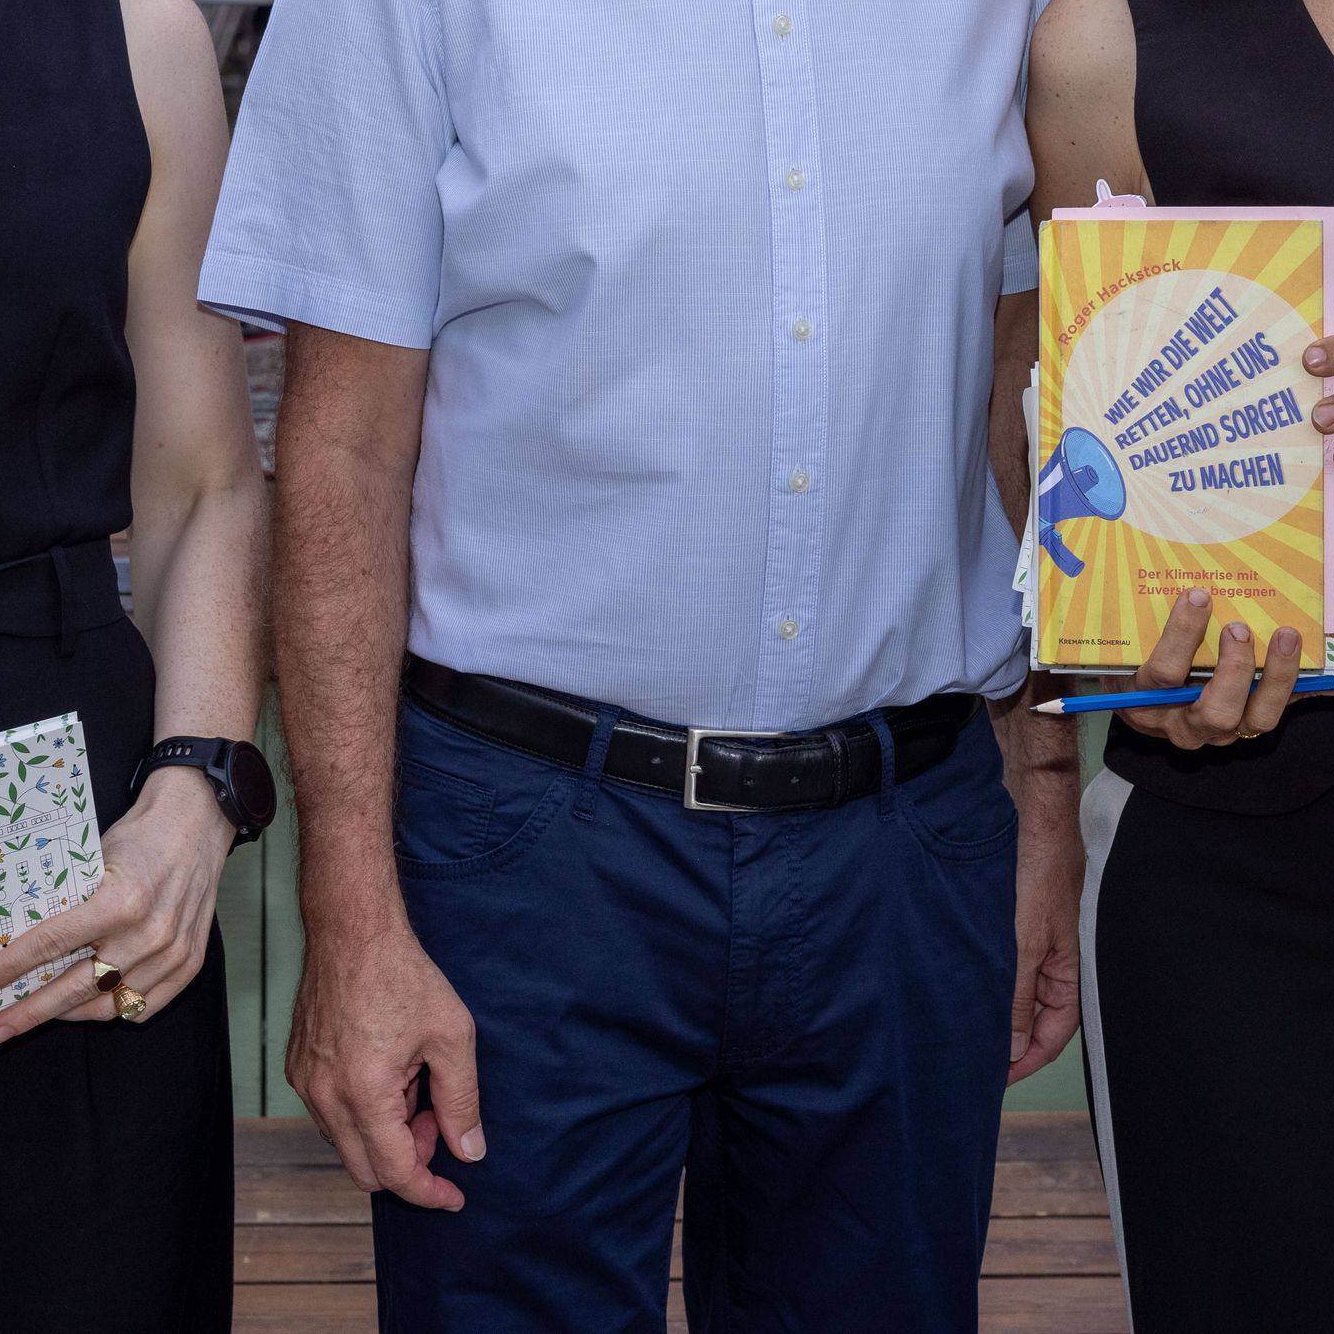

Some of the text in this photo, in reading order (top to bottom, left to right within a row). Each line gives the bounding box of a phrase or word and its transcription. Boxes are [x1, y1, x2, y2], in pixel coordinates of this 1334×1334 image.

[1058, 259, 1182, 345] Roger Hackstock
[1104, 286, 1239, 425] WIE WIR DIE WELT
[1114, 332, 1280, 450] RETTEN, OHNE UNS
[1129, 422, 1220, 471] DAUERND
[1220, 387, 1303, 443] SORGEN
[1169, 452, 1285, 492] ZU MACHEN
[1138, 569, 1259, 581] Der Klimakrise mit
[1138, 584, 1276, 598] Zuversi begegnen
